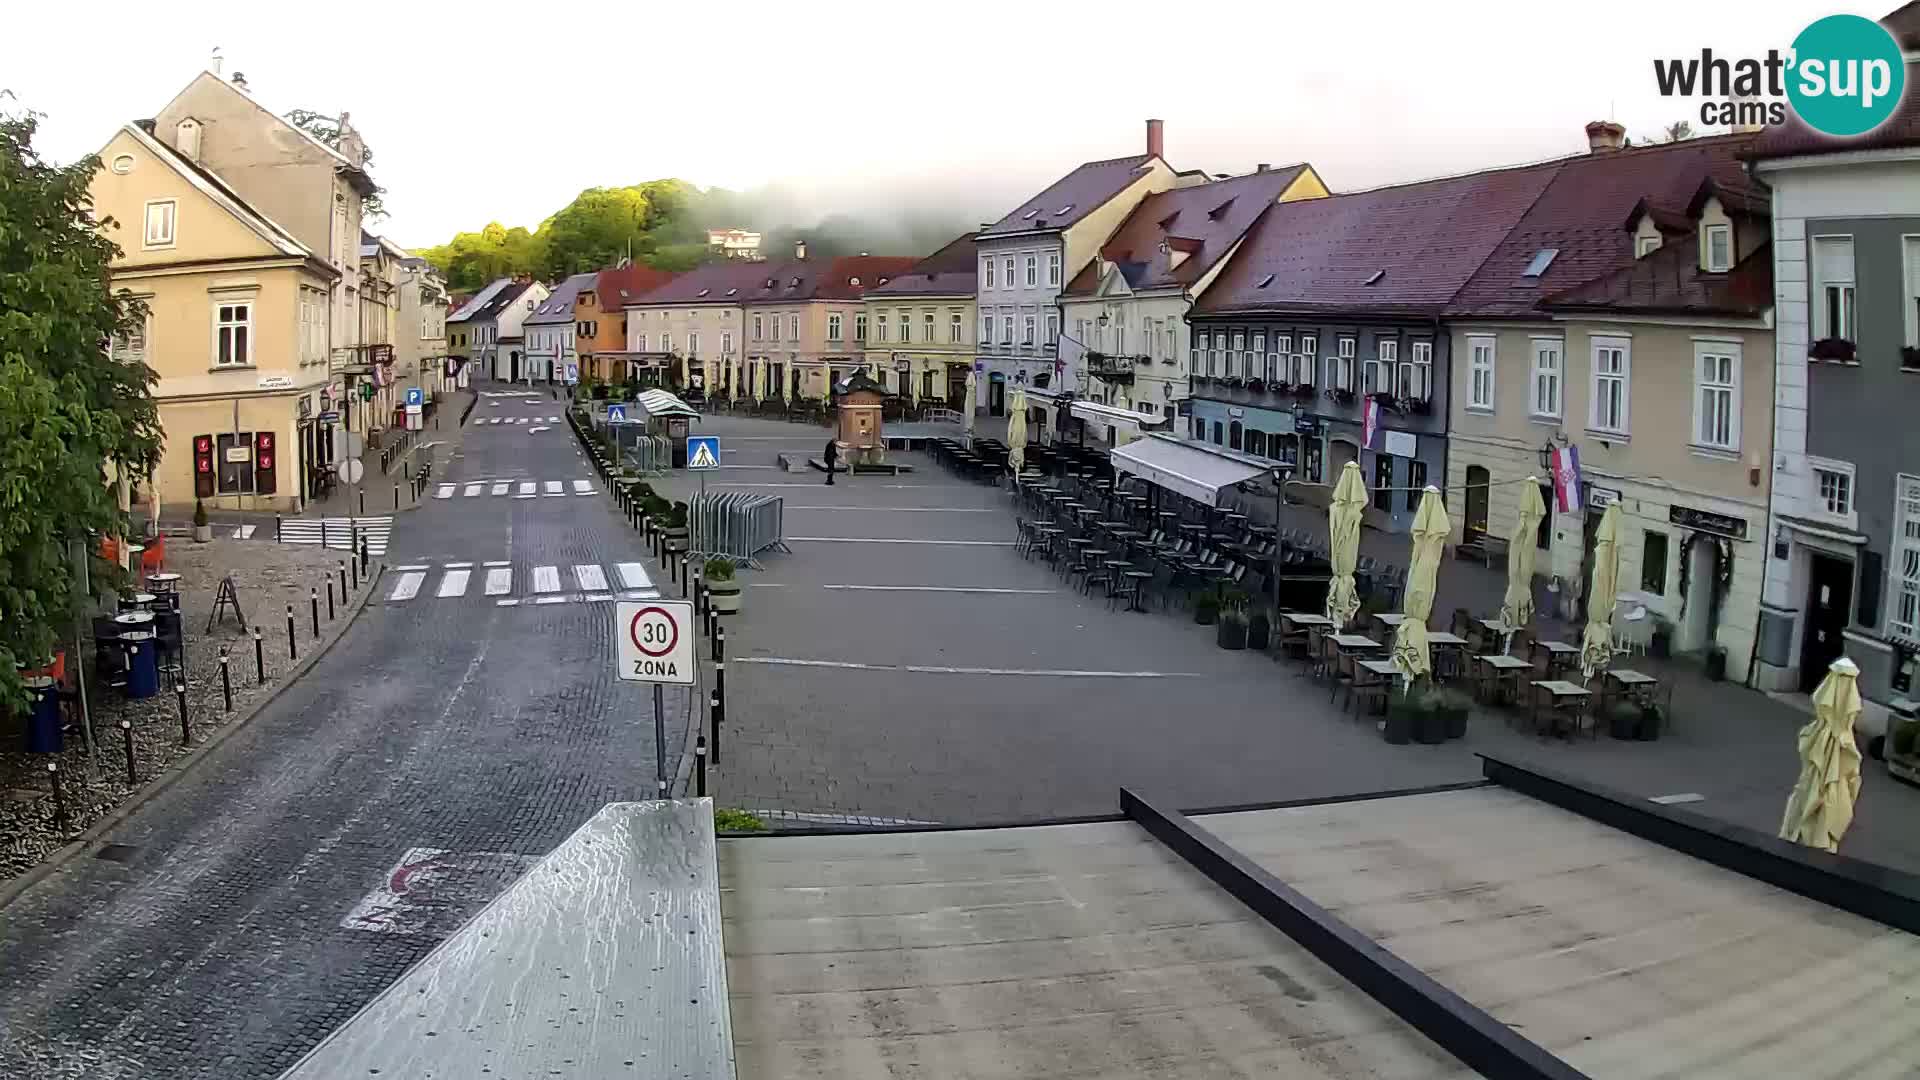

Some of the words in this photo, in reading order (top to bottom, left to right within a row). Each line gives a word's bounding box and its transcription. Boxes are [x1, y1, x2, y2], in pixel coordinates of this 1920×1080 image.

[410, 391, 418, 403] P
[643, 622, 667, 644] 30
[633, 659, 678, 677] ZONA
